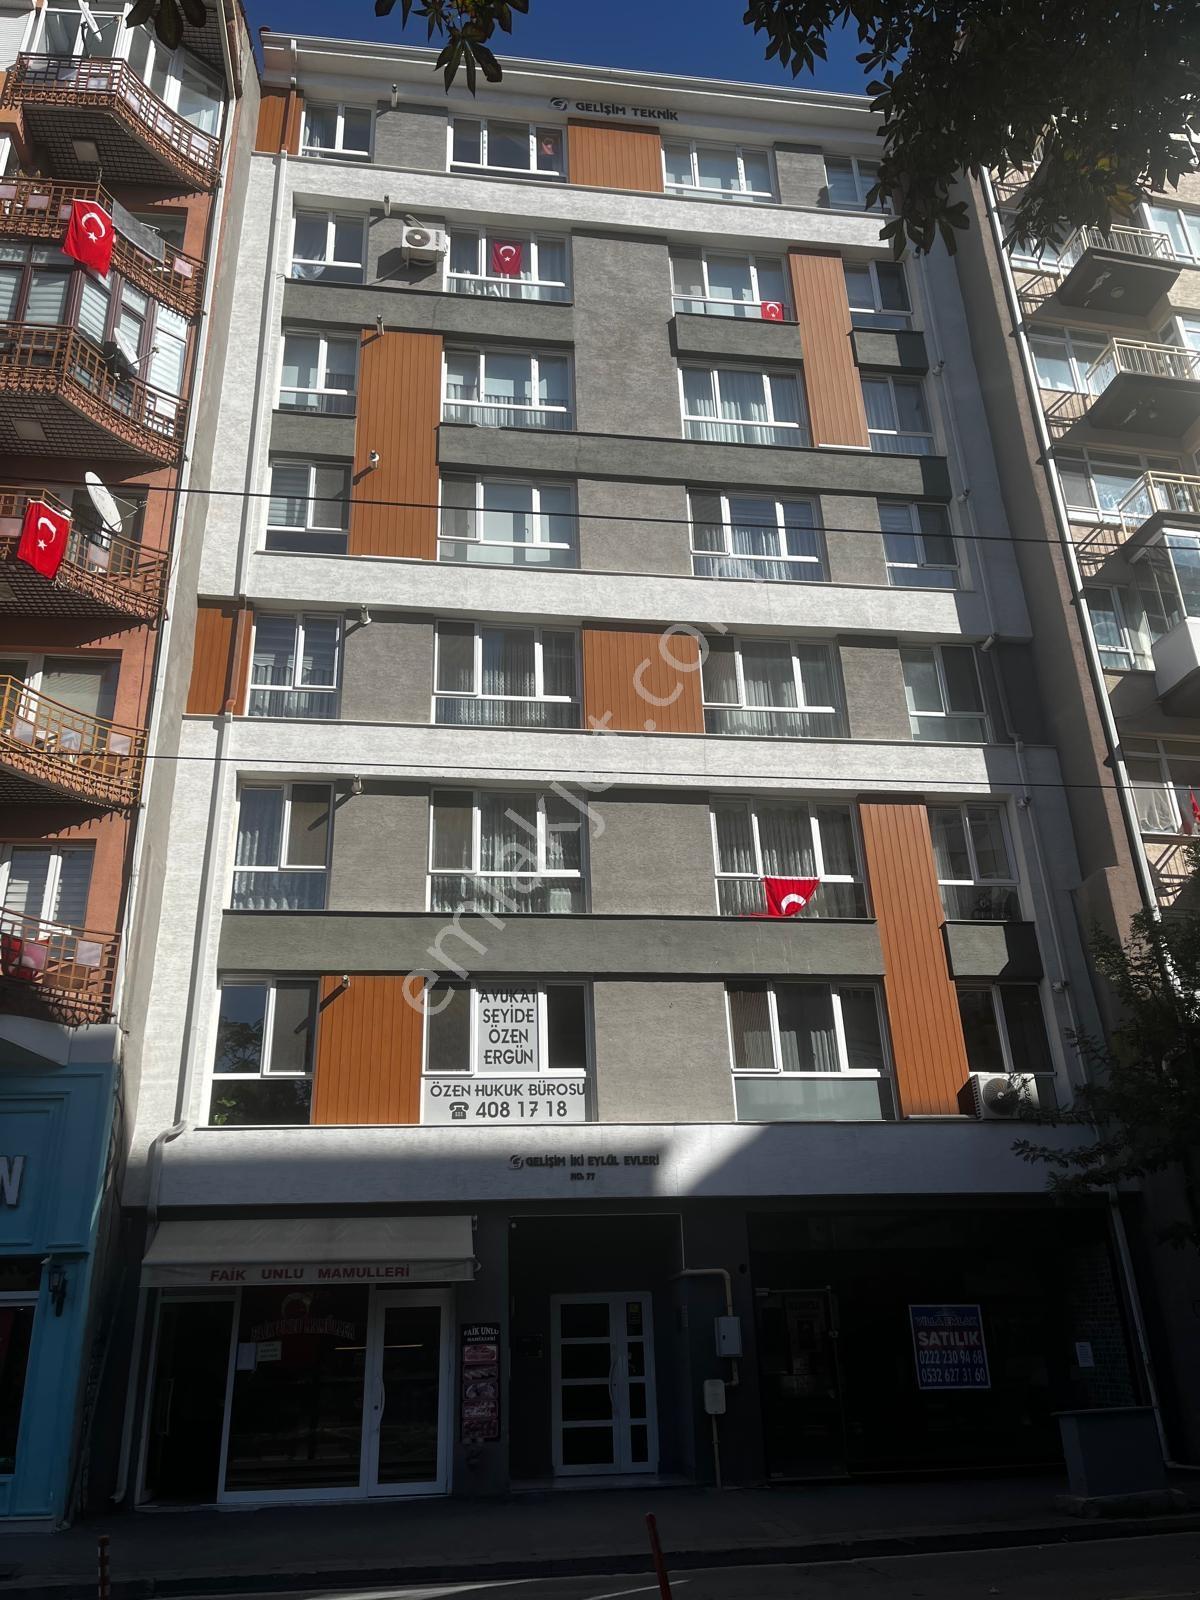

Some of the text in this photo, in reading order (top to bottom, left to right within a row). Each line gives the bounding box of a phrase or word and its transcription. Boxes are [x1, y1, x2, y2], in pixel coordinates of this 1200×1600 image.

[575, 102, 679, 121] GELİŞİM TEKNİK
[482, 1004, 534, 1023] SEYİDE
[488, 1024, 529, 1044] ÖZEN
[483, 1044, 534, 1065] ERGÜN
[430, 1080, 585, 1097] ÖZEN HUKUK BÜROSU
[475, 1100, 568, 1118] 408 17 18
[623, 1153, 660, 1167] EVLERİ
[210, 1264, 410, 1282] FAİK UNLU MAMULLERİ
[917, 1331, 981, 1347] SATILIK
